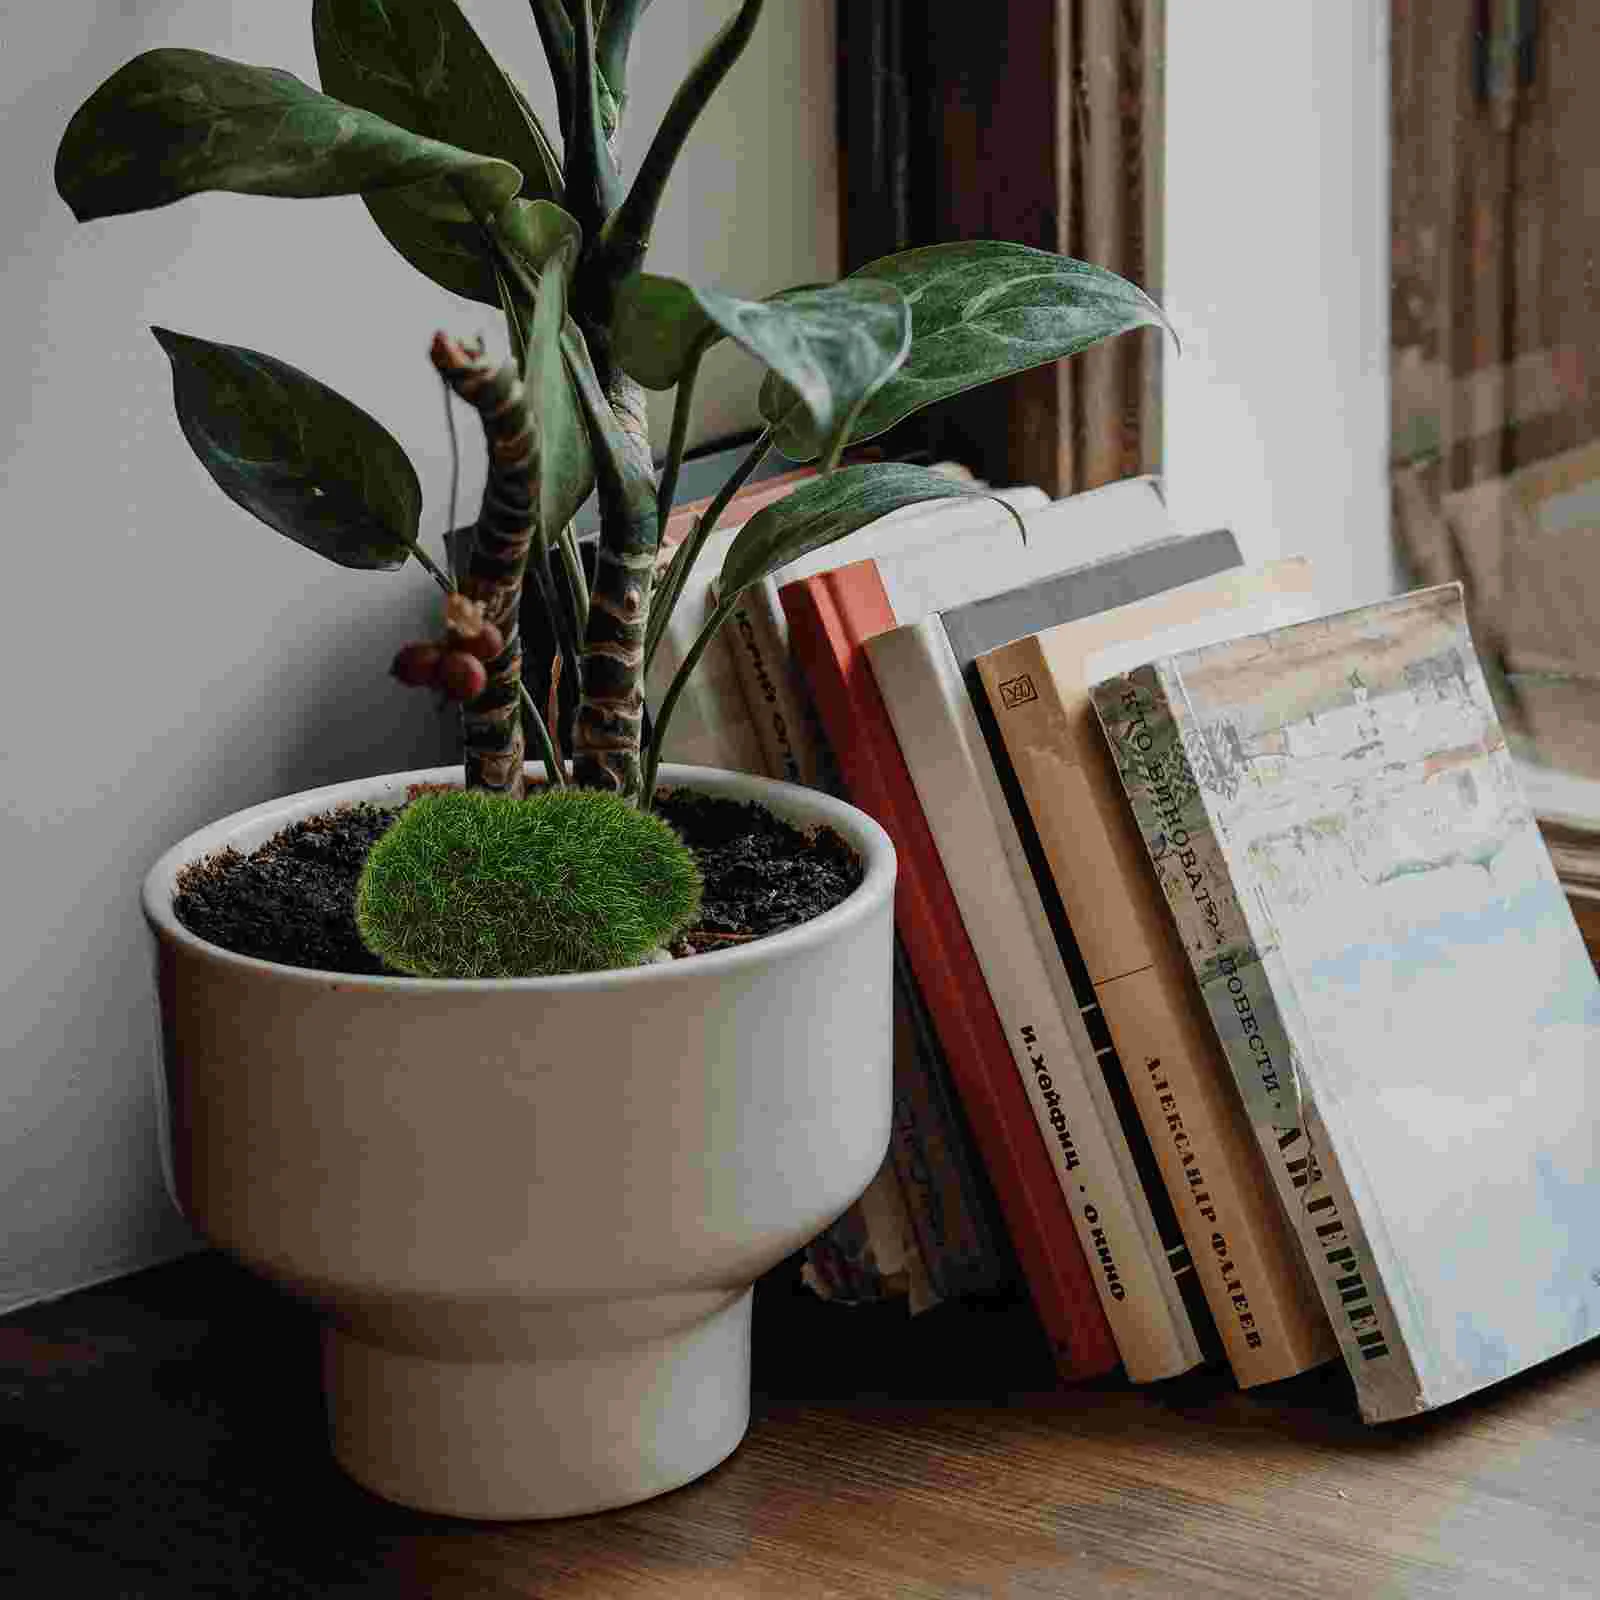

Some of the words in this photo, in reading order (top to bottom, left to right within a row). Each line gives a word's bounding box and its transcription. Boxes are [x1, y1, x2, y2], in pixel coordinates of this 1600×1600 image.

[1216, 957, 1281, 1097] ПОВЕСТИ
[1144, 1056, 1217, 1224] АЛЕКСАНДР
[1211, 1231, 1263, 1350] ФАДЕЕВ
